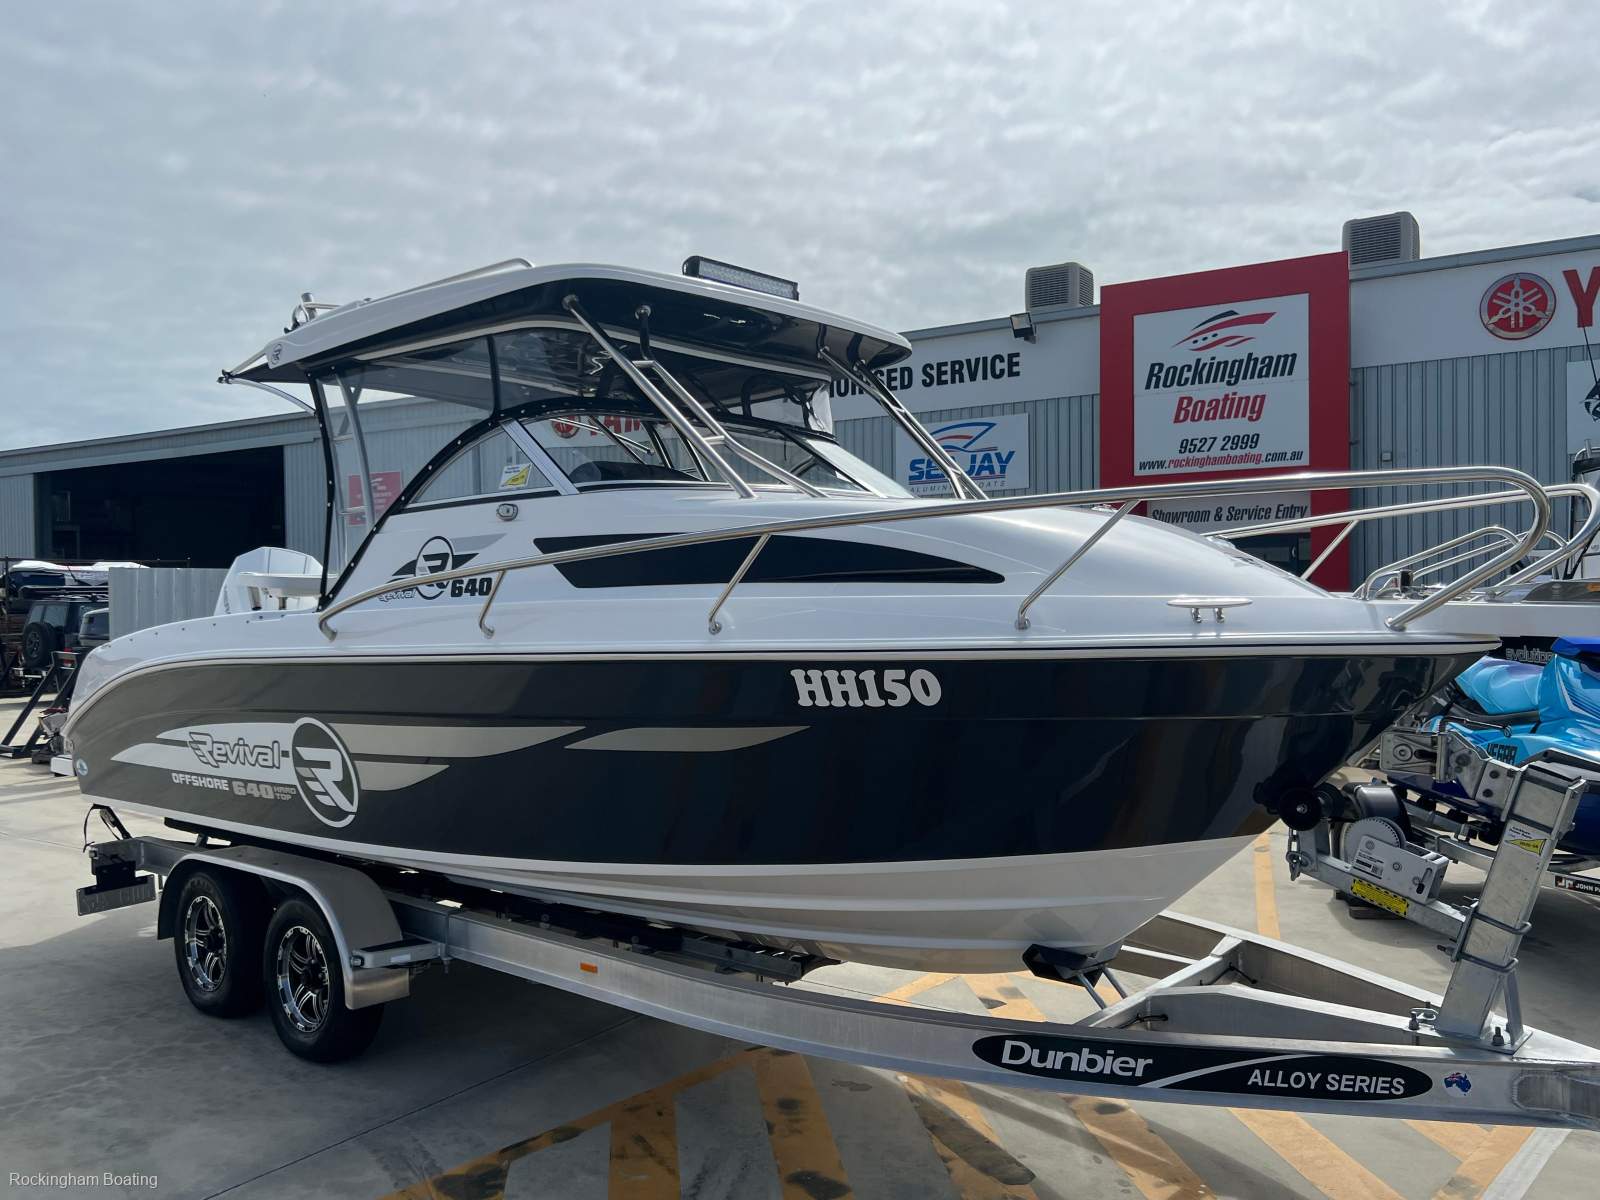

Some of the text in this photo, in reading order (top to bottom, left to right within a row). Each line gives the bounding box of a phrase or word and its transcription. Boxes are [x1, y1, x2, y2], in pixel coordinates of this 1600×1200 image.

[922, 352, 1021, 388] SERVICE
[1145, 352, 1298, 390] Rockingham
[1173, 392, 1267, 424] Boating
[1179, 433, 1260, 455] 9527 2999
[1139, 449, 1304, 472] www.rockinghamboating.com.au
[1152, 503, 1308, 524] Showroom & Service Entry
[451, 577, 493, 598] 640
[790, 669, 942, 707] HH150
[188, 732, 281, 769] Revival
[171, 772, 229, 791] OFFSHORE
[232, 780, 274, 799] 640
[275, 792, 292, 801] TOP
[1575, 883, 1594, 892] JOHN
[1001, 1039, 1153, 1077] Dunbier
[1248, 1069, 1405, 1095] ALLOY SERIES
